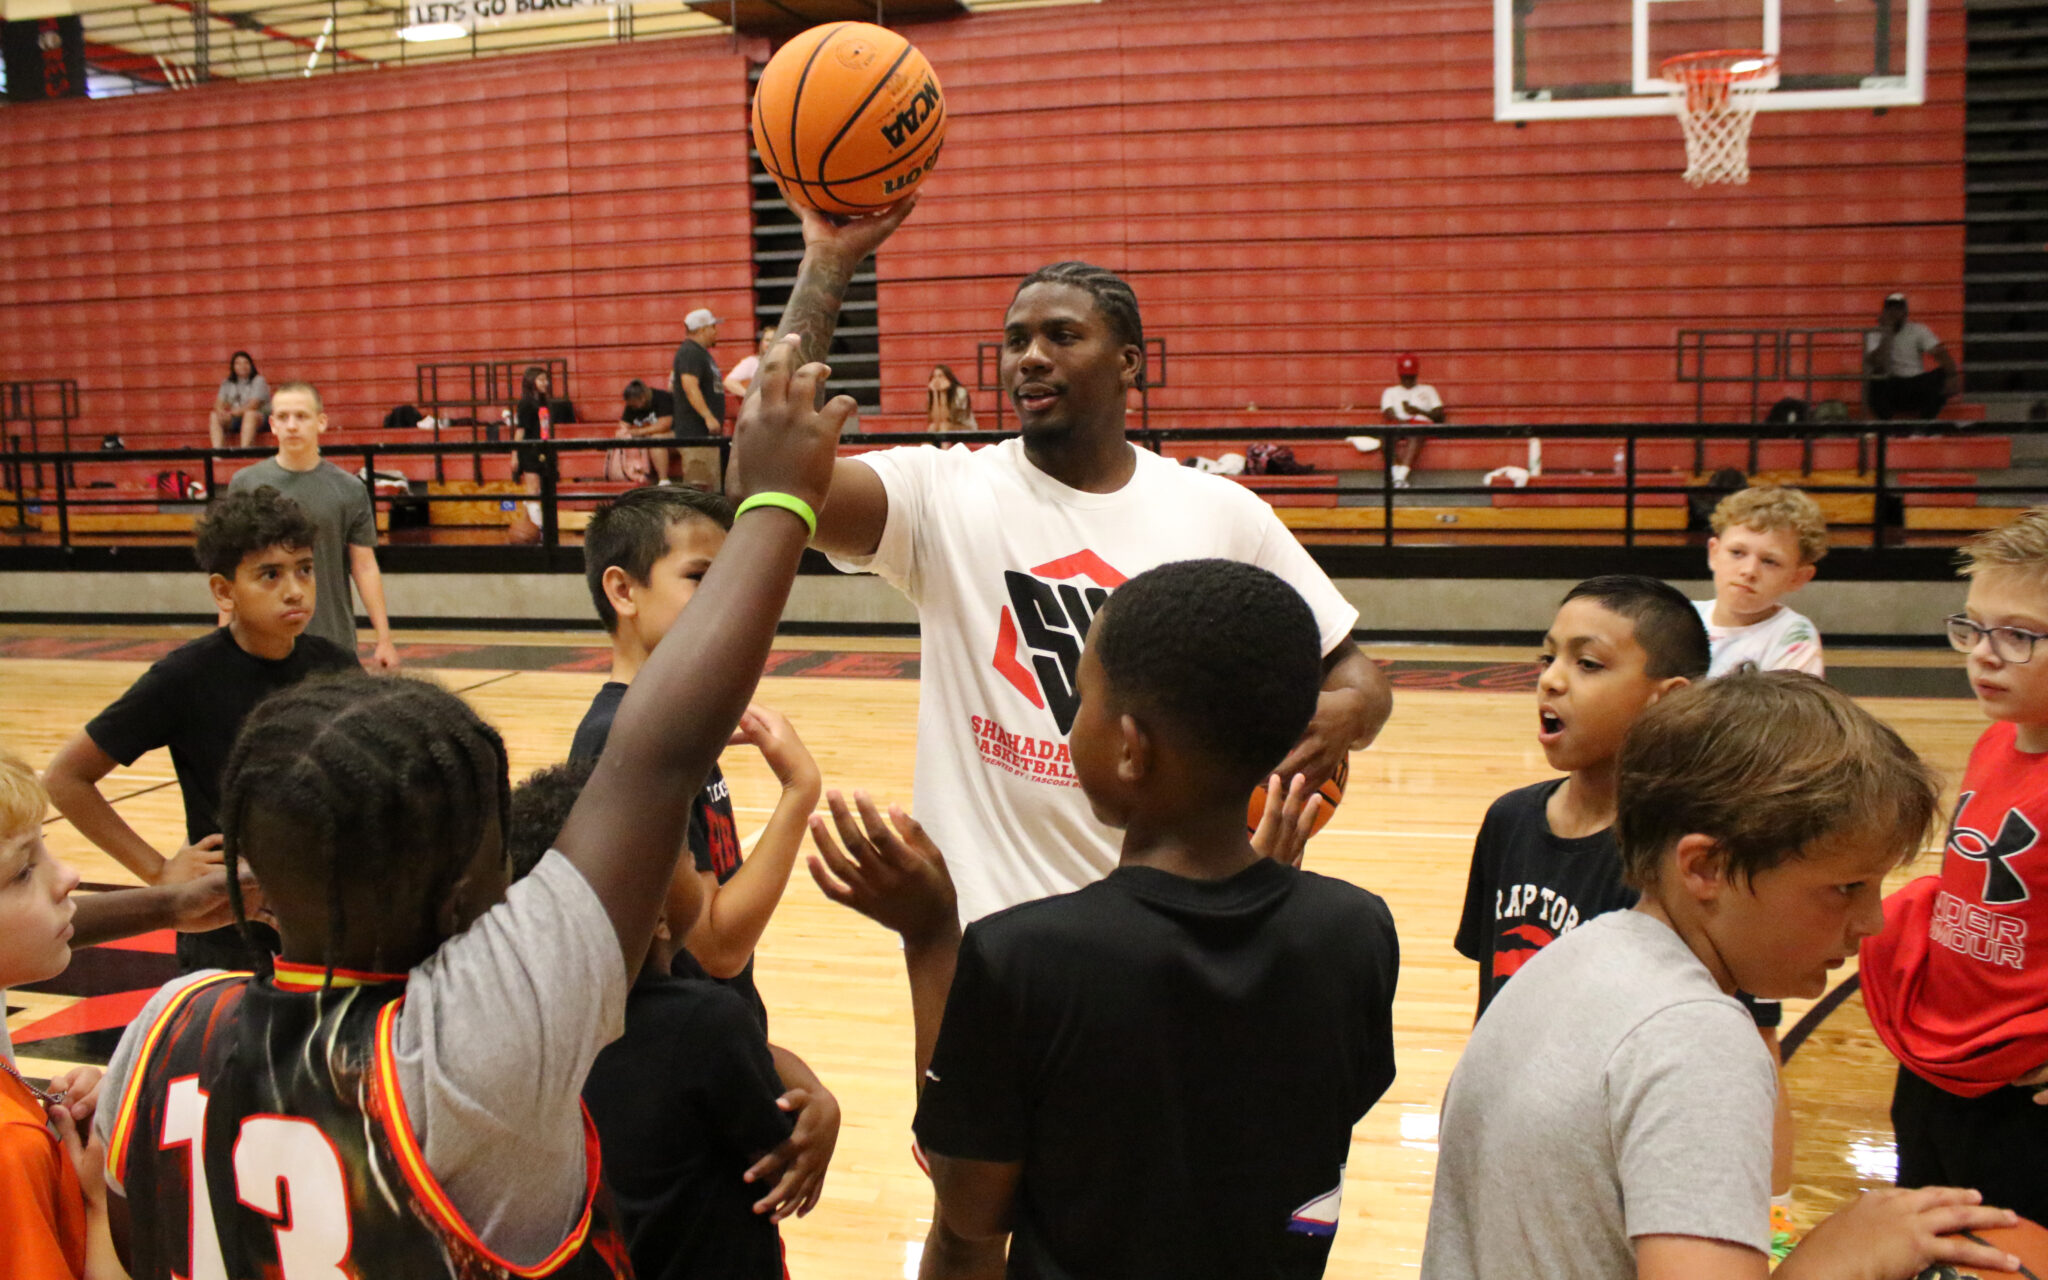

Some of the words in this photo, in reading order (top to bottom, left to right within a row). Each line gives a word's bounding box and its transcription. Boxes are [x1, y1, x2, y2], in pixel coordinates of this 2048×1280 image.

[416, 1, 467, 24] LETS
[473, 0, 506, 17] GO
[881, 74, 940, 149] NCAA
[974, 735, 1079, 780] BASKETBAL
[1496, 884, 1581, 935] RAPTOR
[158, 1073, 352, 1280] 13
